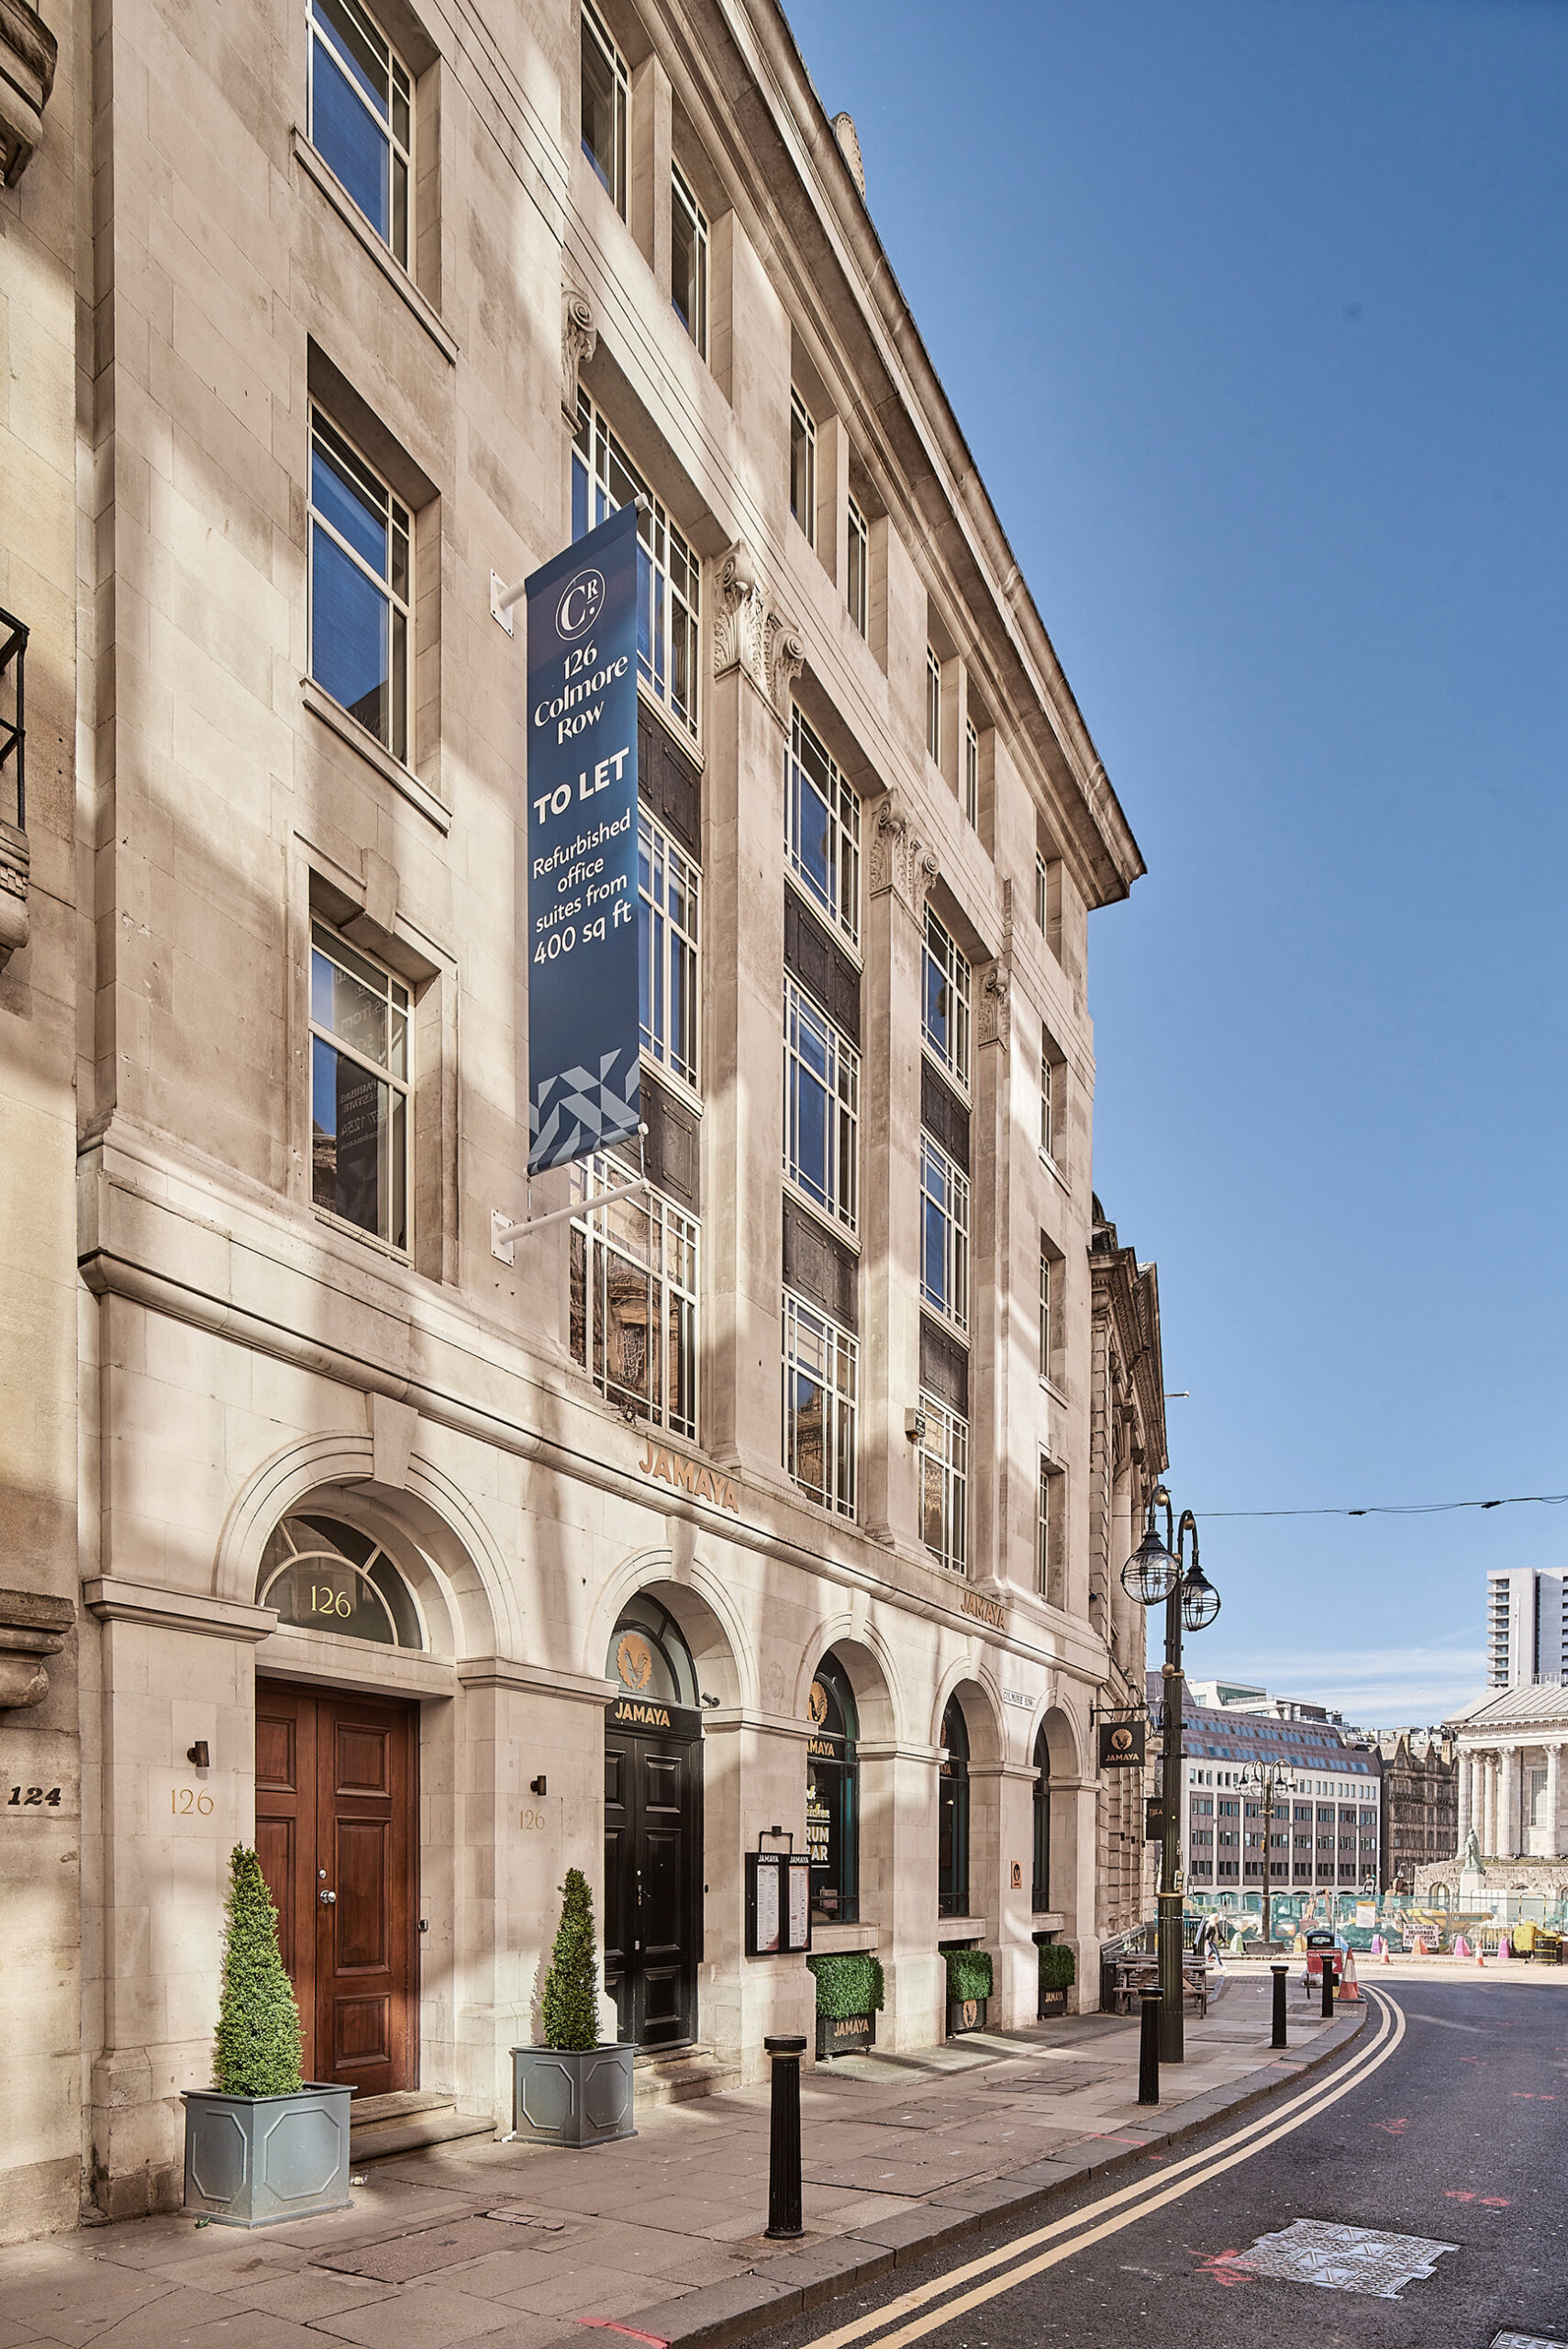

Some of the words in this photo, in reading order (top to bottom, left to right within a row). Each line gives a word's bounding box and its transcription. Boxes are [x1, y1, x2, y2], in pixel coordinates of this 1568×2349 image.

[563, 640, 597, 680] 126
[534, 655, 628, 727] Colmore
[558, 701, 605, 745] Row
[533, 784, 573, 825] TO
[579, 747, 629, 801] LET
[533, 807, 631, 879] Refurbished
[557, 857, 604, 894] office
[536, 898, 582, 933] suites
[585, 874, 628, 907] from
[533, 926, 576, 964] 400
[582, 917, 606, 941] sq
[612, 899, 632, 929] ft
[639, 1442, 739, 1514] JAMAYA
[311, 1585, 351, 1618] 126
[961, 1592, 1006, 1630] JAMAYA
[615, 1701, 671, 1728] JAMAYA
[806, 1740, 835, 1757] MAYA
[1106, 1753, 1140, 1762] JAMAYA
[7, 1786, 61, 1806] 124
[172, 1787, 214, 1815] 126
[520, 1809, 545, 1831] 126
[806, 1826, 829, 1842] RUM
[758, 1854, 779, 1863] JAMAYA
[790, 1855, 809, 1864] JAMAYA
[834, 2019, 869, 2037] JAMAYA
